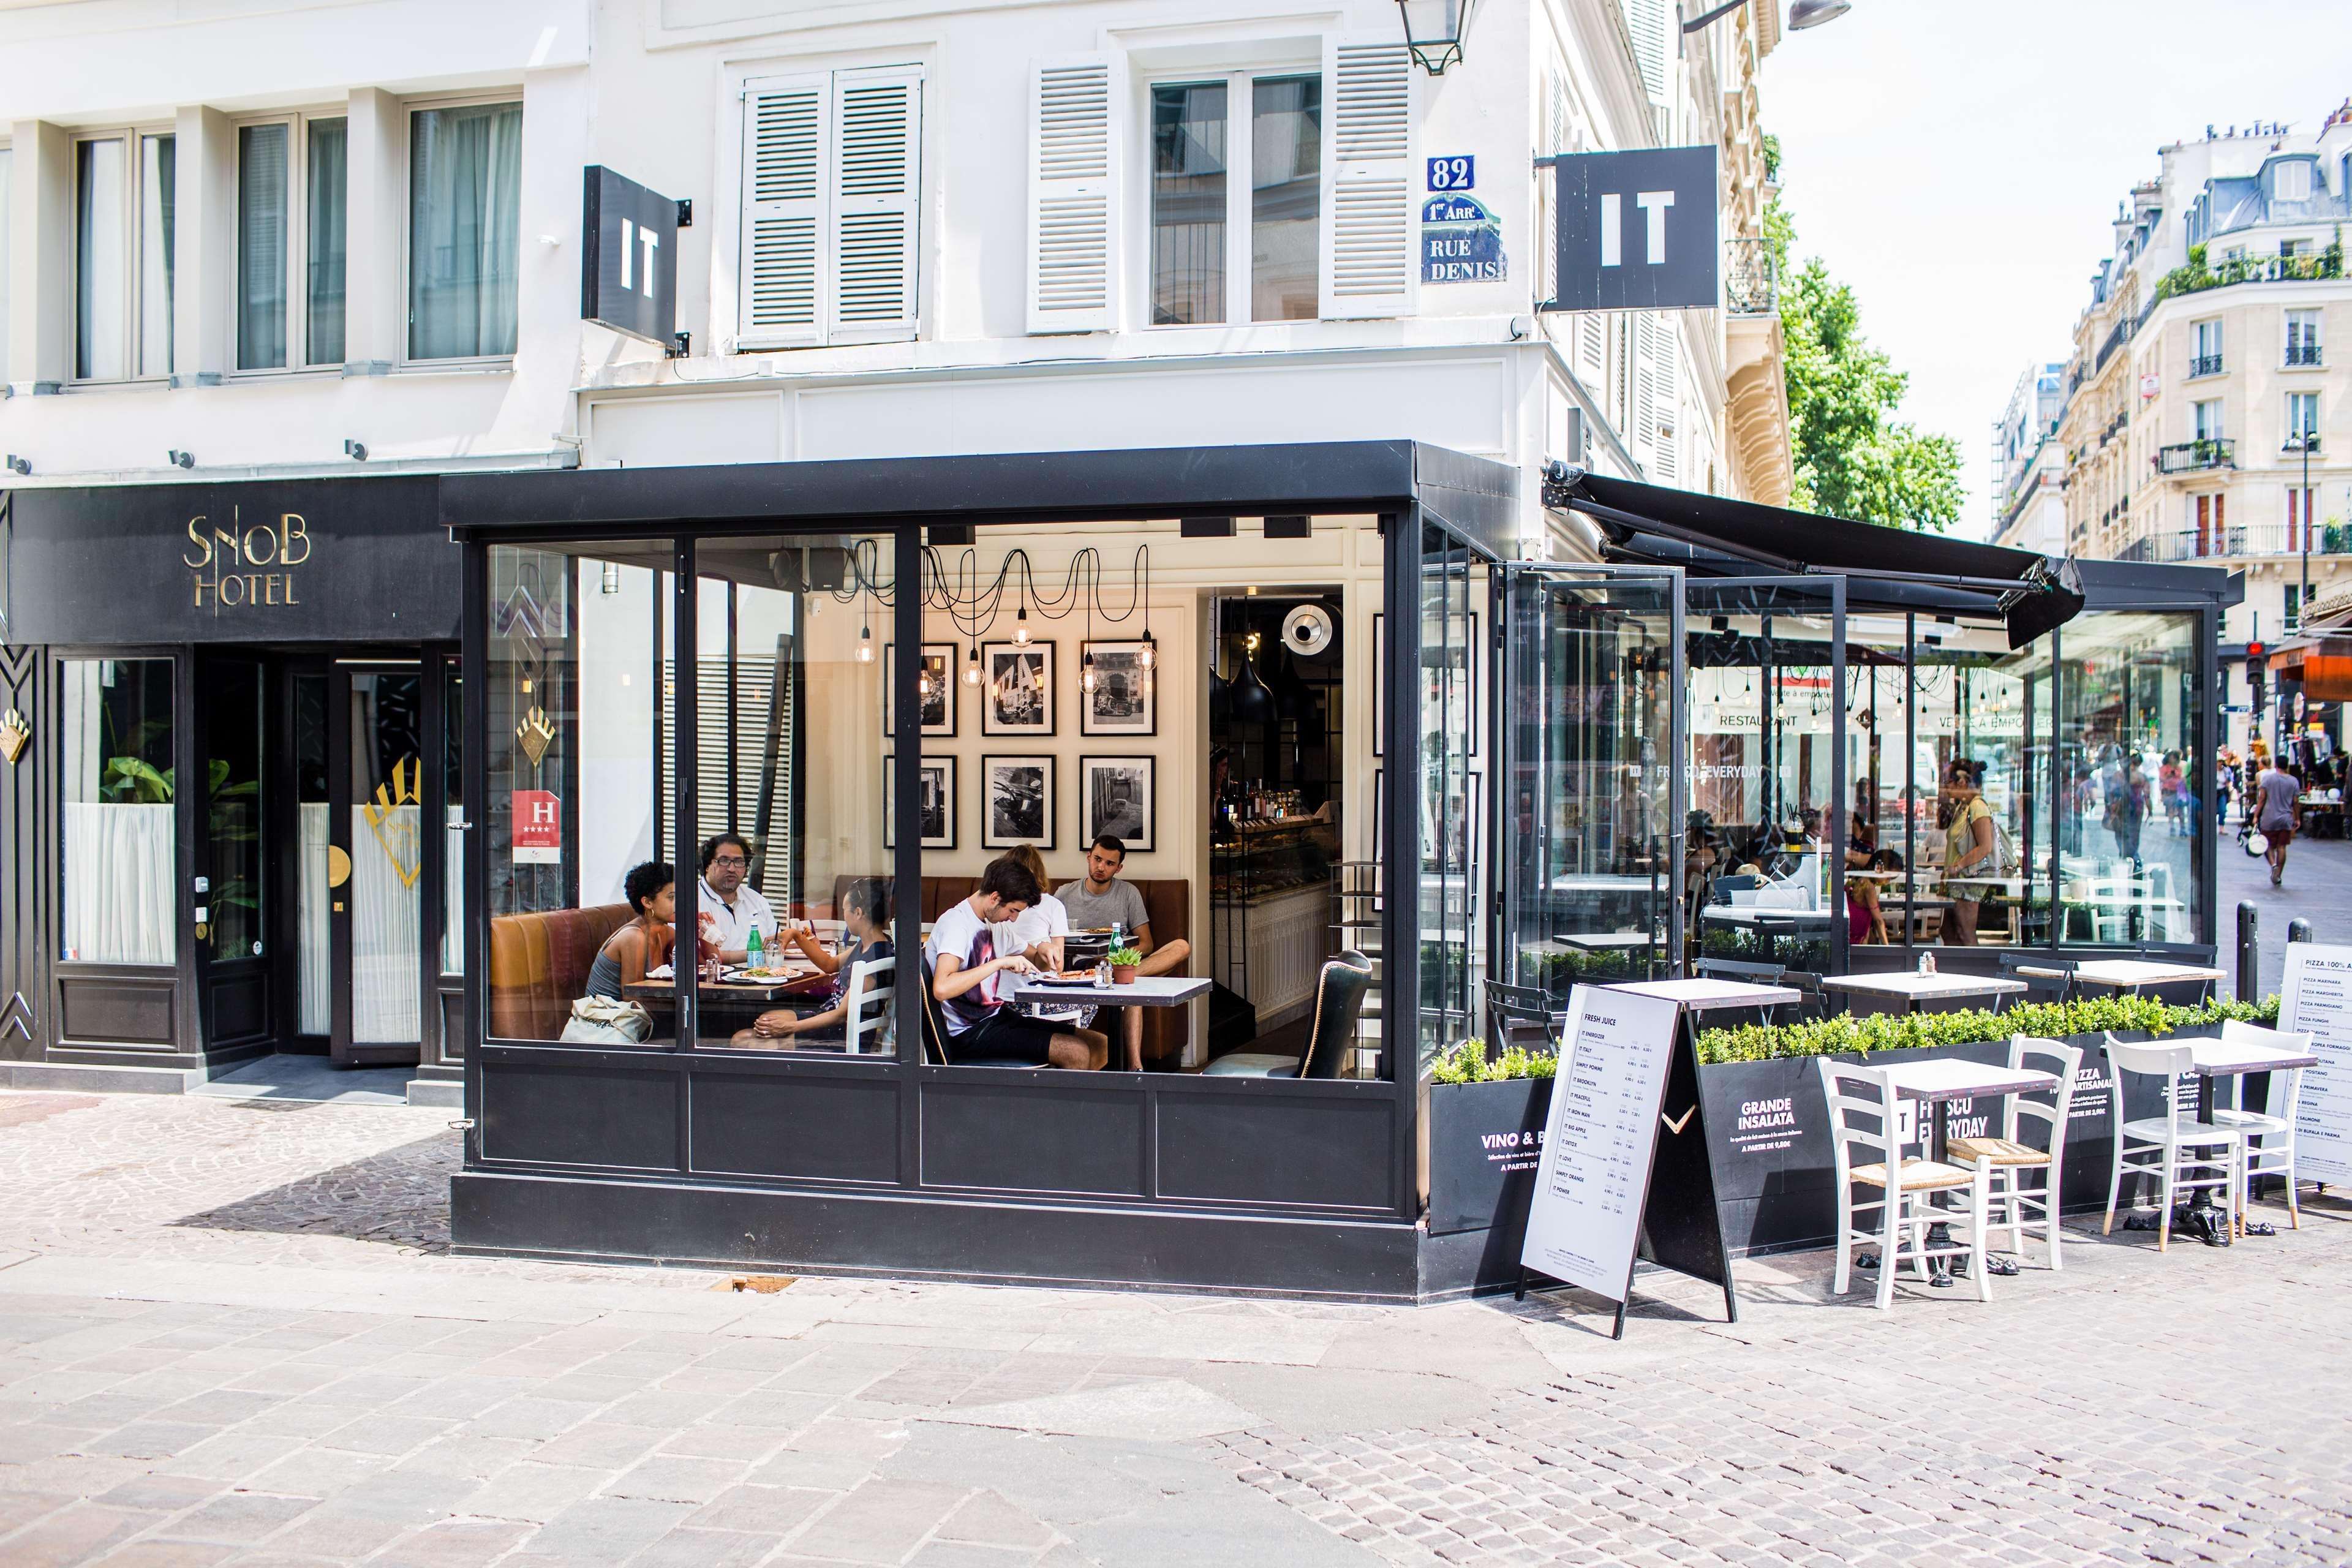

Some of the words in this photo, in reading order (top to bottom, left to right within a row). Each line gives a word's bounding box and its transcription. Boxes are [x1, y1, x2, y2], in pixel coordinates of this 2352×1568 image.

[1432, 159, 1468, 188] 82
[1601, 191, 1675, 266] IT
[1430, 239, 1471, 257] RUE
[621, 218, 658, 298] IT
[1431, 262, 1497, 280] DENIS
[184, 505, 310, 567] SNOB
[195, 573, 299, 612] HOTEL
[1708, 766, 1763, 778] EVERYDAY
[532, 802, 555, 823] H
[1584, 1014, 1600, 1023] FRESH
[1602, 1017, 1616, 1026] JUICE
[1577, 1078, 1596, 1087] BROOKLYN
[2075, 1068, 2100, 1082] IZZA
[1574, 1093, 1591, 1102] PEACEFUL
[1741, 1098, 1792, 1115] GRANDE
[1738, 1112, 1795, 1130] INSALATA
[1481, 1133, 1518, 1149] VINO
[1523, 1132, 1534, 1145] &
[1569, 1174, 1585, 1183] ORANGE
